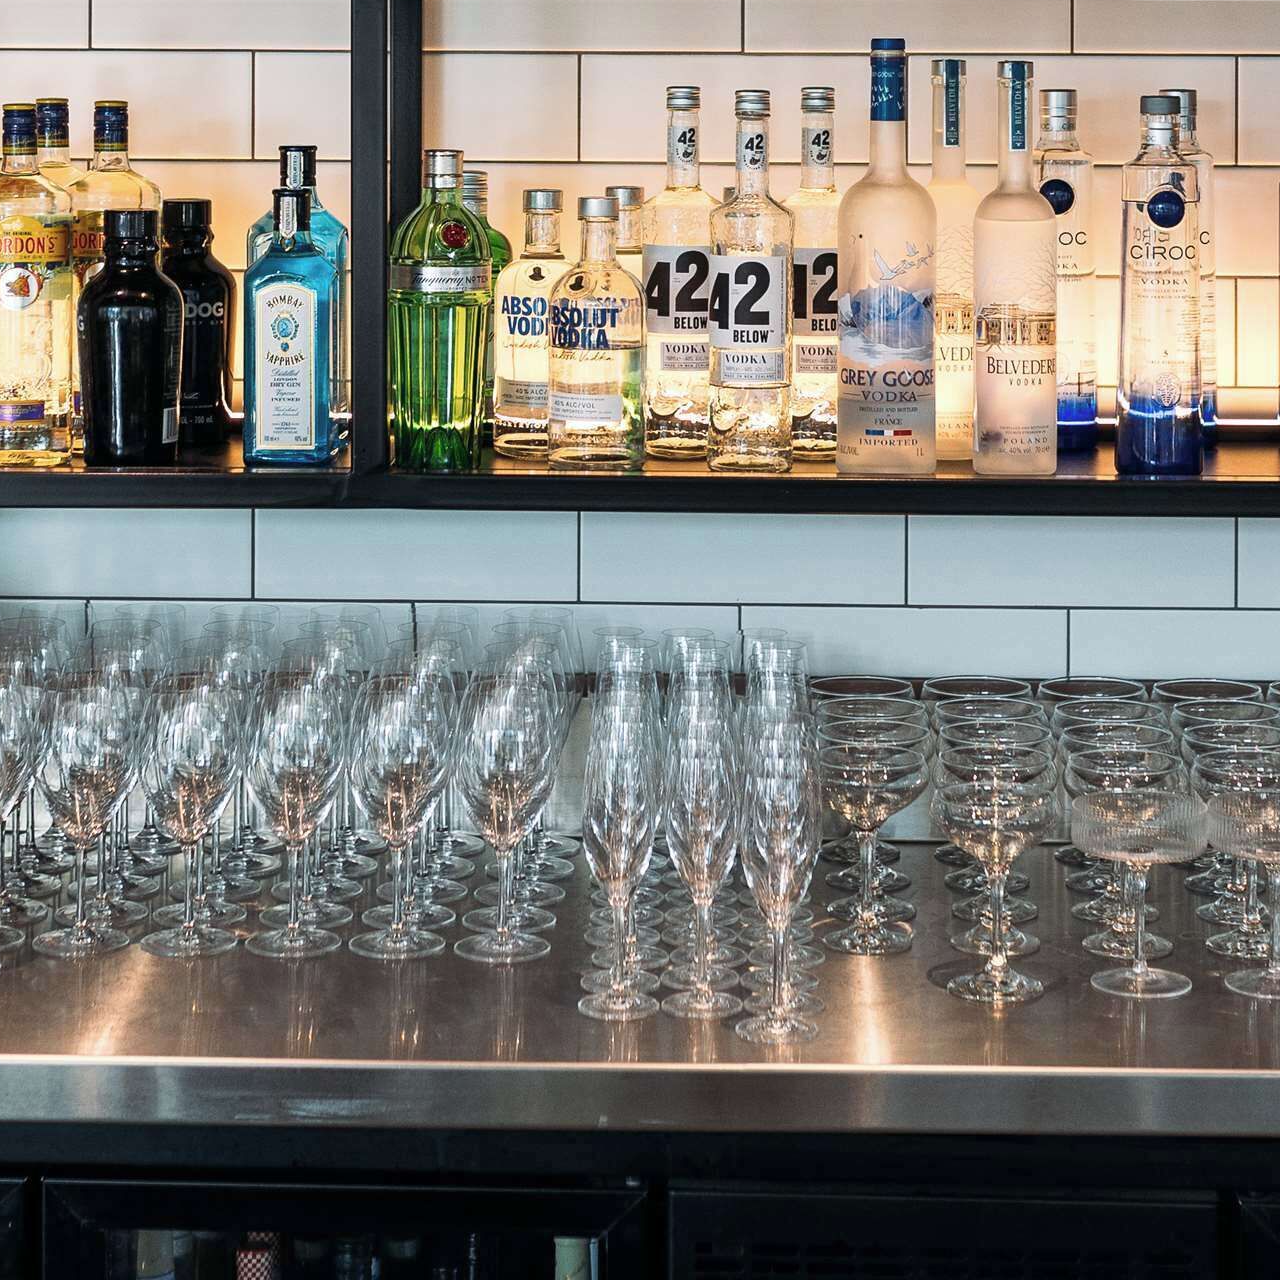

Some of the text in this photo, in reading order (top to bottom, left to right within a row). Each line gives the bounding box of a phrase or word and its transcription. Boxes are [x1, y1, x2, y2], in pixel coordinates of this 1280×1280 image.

[678, 127, 697, 147] 42
[744, 133, 764, 152] 42
[811, 128, 830, 147] 42
[1130, 243, 1196, 261] CÎROC
[411, 271, 464, 288] Tanqueray
[646, 250, 709, 317] 42
[1140, 277, 1190, 286] VODKA
[267, 295, 305, 311] BOMBAY
[709, 261, 771, 330] 42
[186, 301, 224, 319] DOG
[673, 316, 708, 330] BELOW
[551, 328, 609, 350] VODKA
[732, 329, 769, 343] BELOW
[665, 344, 707, 354] VODKA
[265, 350, 306, 366] SAPPHIRE
[725, 353, 767, 365] VODKA
[987, 356, 1056, 376] BELVEDERE
[840, 369, 880, 386] GREY
[882, 369, 934, 386] GOOSE
[1009, 378, 1042, 386] VODKA
[861, 391, 918, 403] VODKA
[858, 438, 918, 447] IMPORTED
[1003, 436, 1049, 445] POLAND
